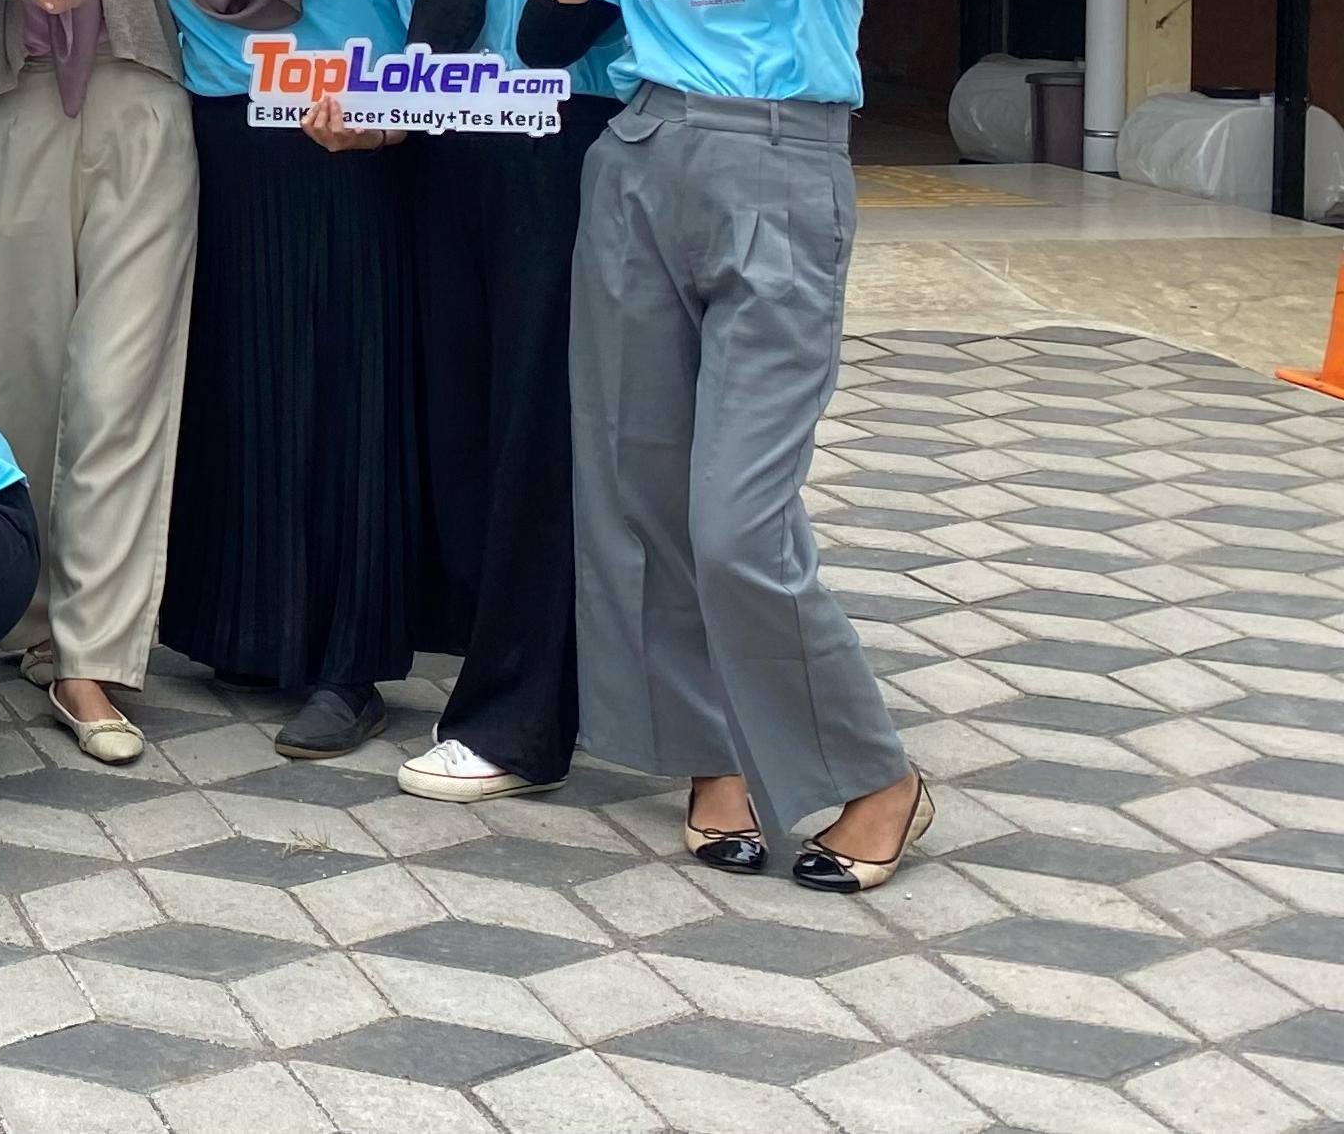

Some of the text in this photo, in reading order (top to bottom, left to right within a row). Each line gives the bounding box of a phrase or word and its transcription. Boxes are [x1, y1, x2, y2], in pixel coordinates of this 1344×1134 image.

[252, 42, 563, 103] TopLoker.com
[389, 108, 494, 129] Study+Tes
[500, 110, 557, 129] Kerja
